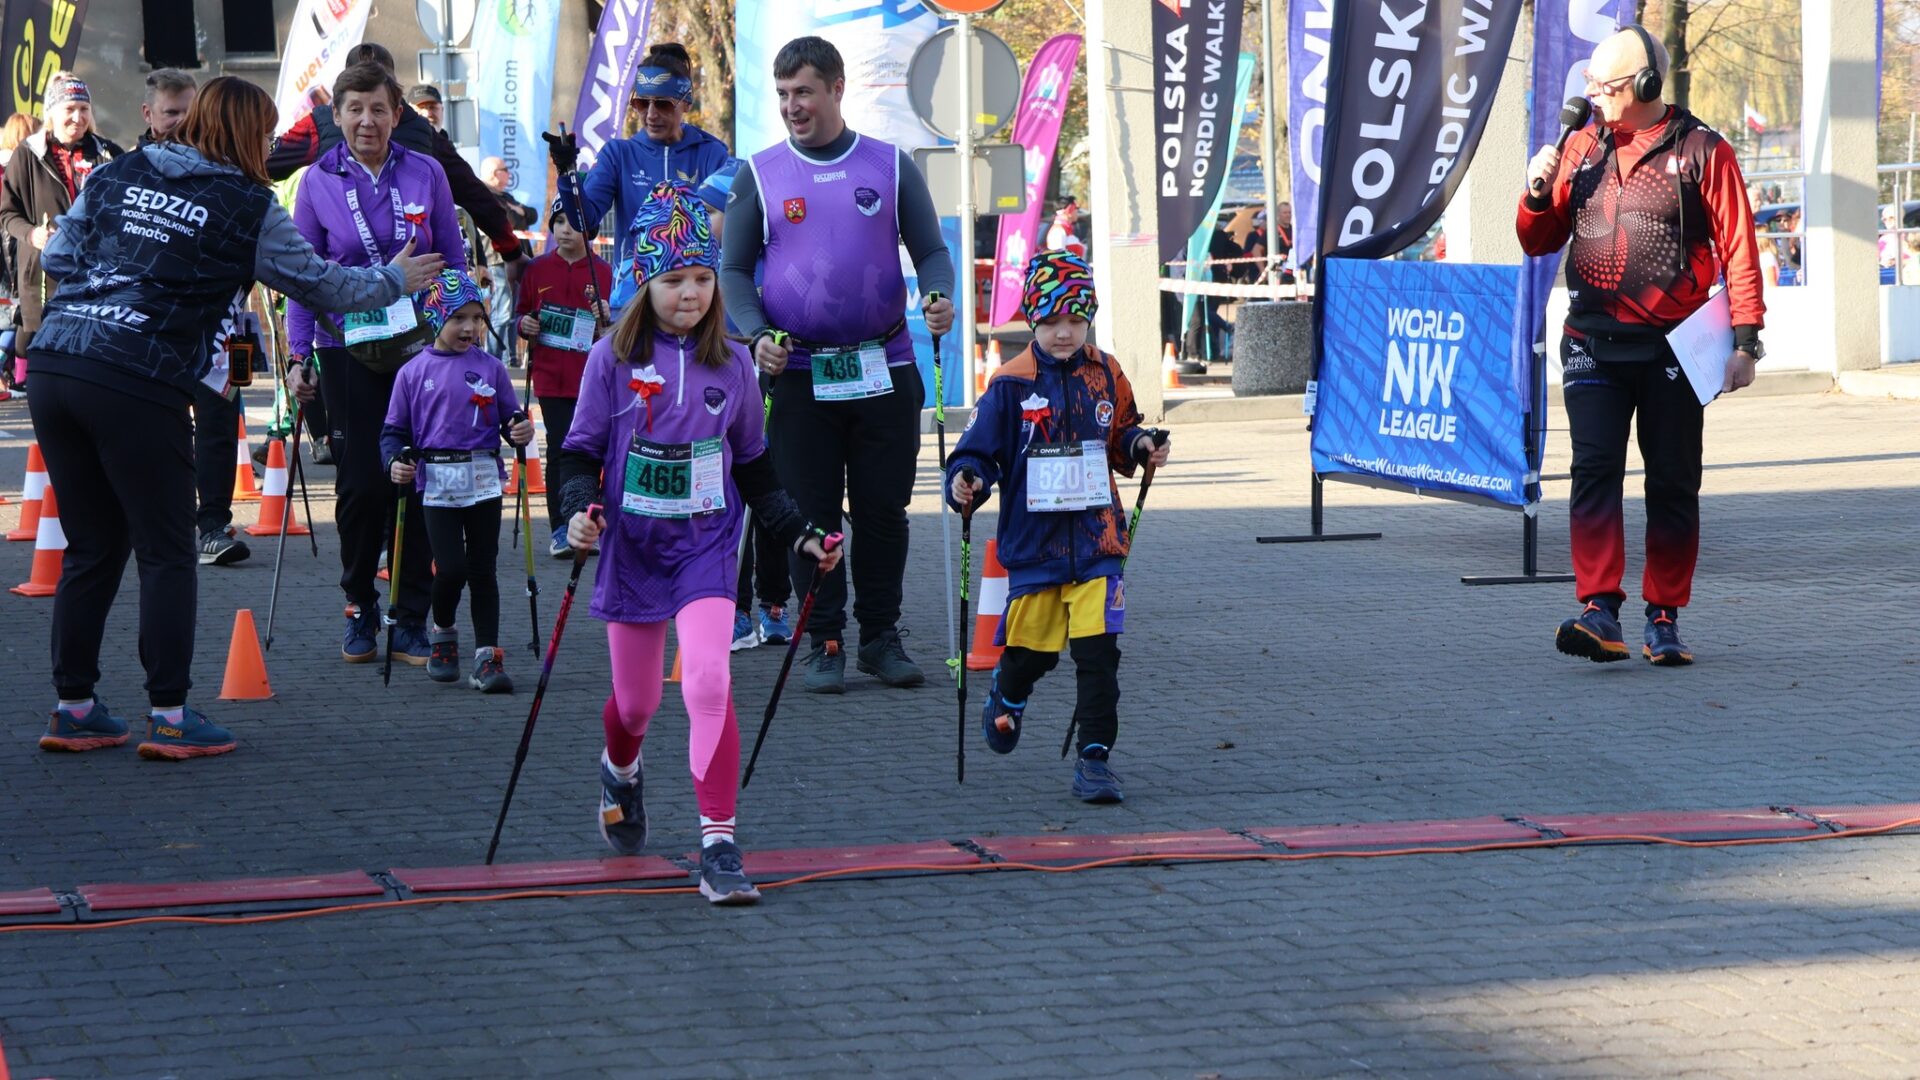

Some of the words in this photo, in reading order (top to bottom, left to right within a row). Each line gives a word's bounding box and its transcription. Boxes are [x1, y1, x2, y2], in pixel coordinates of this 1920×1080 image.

[1162, 24, 1190, 197] POLSKA
[1189, 92, 1219, 197] NORDIC
[121, 209, 152, 222] NORDIC
[152, 214, 196, 237] WALKING
[122, 186, 209, 228] SĘDZIA
[122, 221, 170, 243] Renata
[542, 314, 572, 336] 460
[1387, 307, 1465, 341] WORLD
[823, 356, 859, 381] 436
[1383, 340, 1460, 409] NW
[1378, 408, 1457, 443] LEAGUE
[434, 466, 470, 491] 529
[637, 463, 686, 496] 465
[1039, 461, 1080, 490] 520
